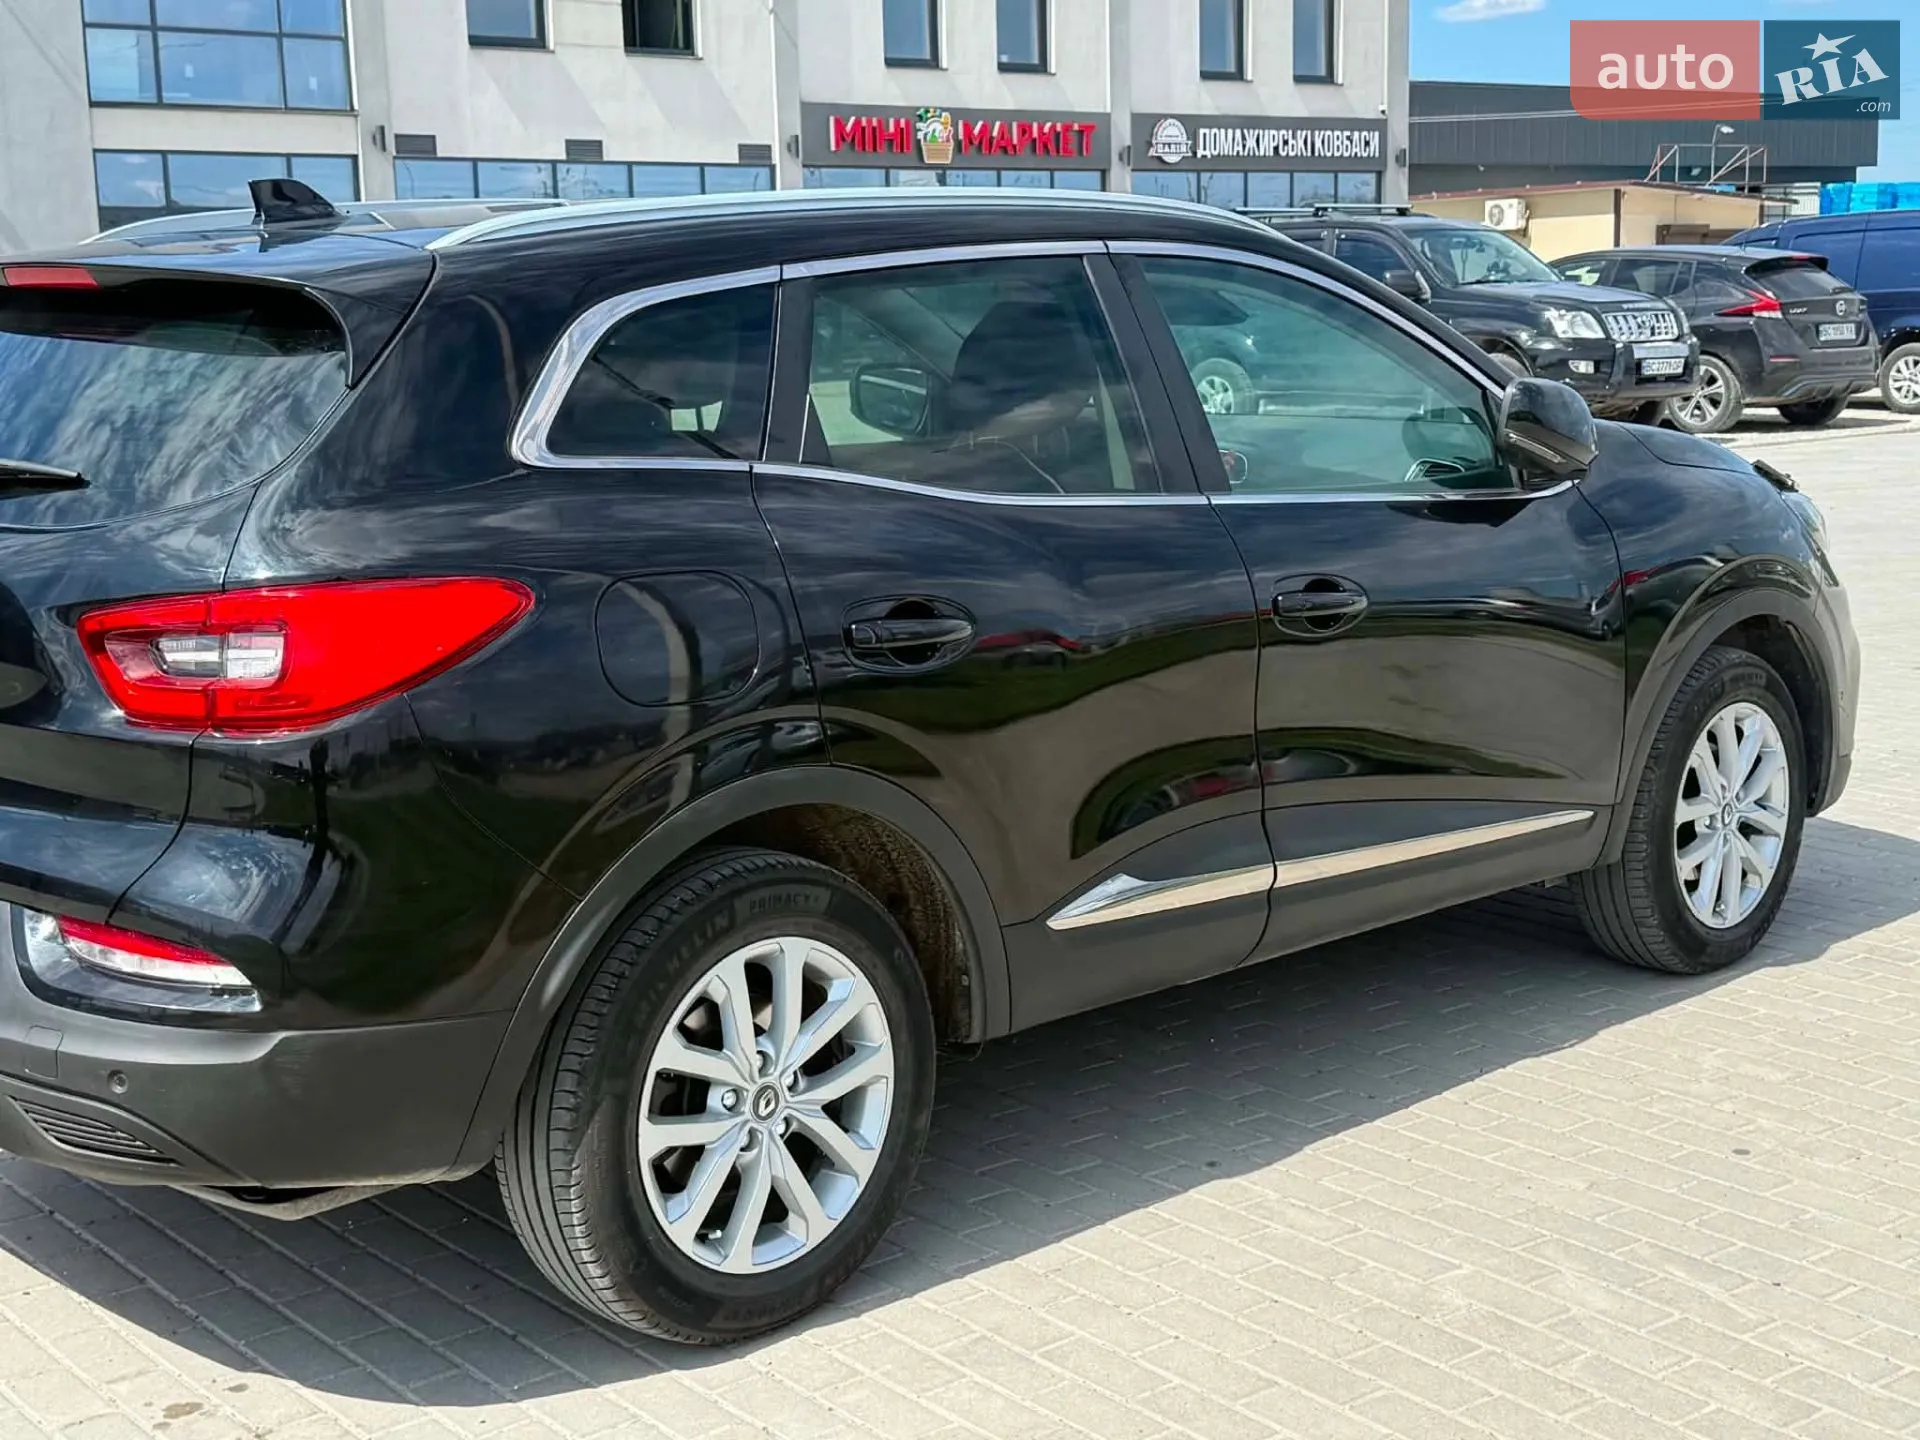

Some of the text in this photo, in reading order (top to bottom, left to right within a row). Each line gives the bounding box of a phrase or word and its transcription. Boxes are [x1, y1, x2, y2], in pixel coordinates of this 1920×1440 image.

[829, 115, 1096, 157] МІНІ МАРКЕТ
[1197, 127, 1312, 158] ДОМАЖИРСЬКІ
[1314, 130, 1380, 158] КОВБАСИ
